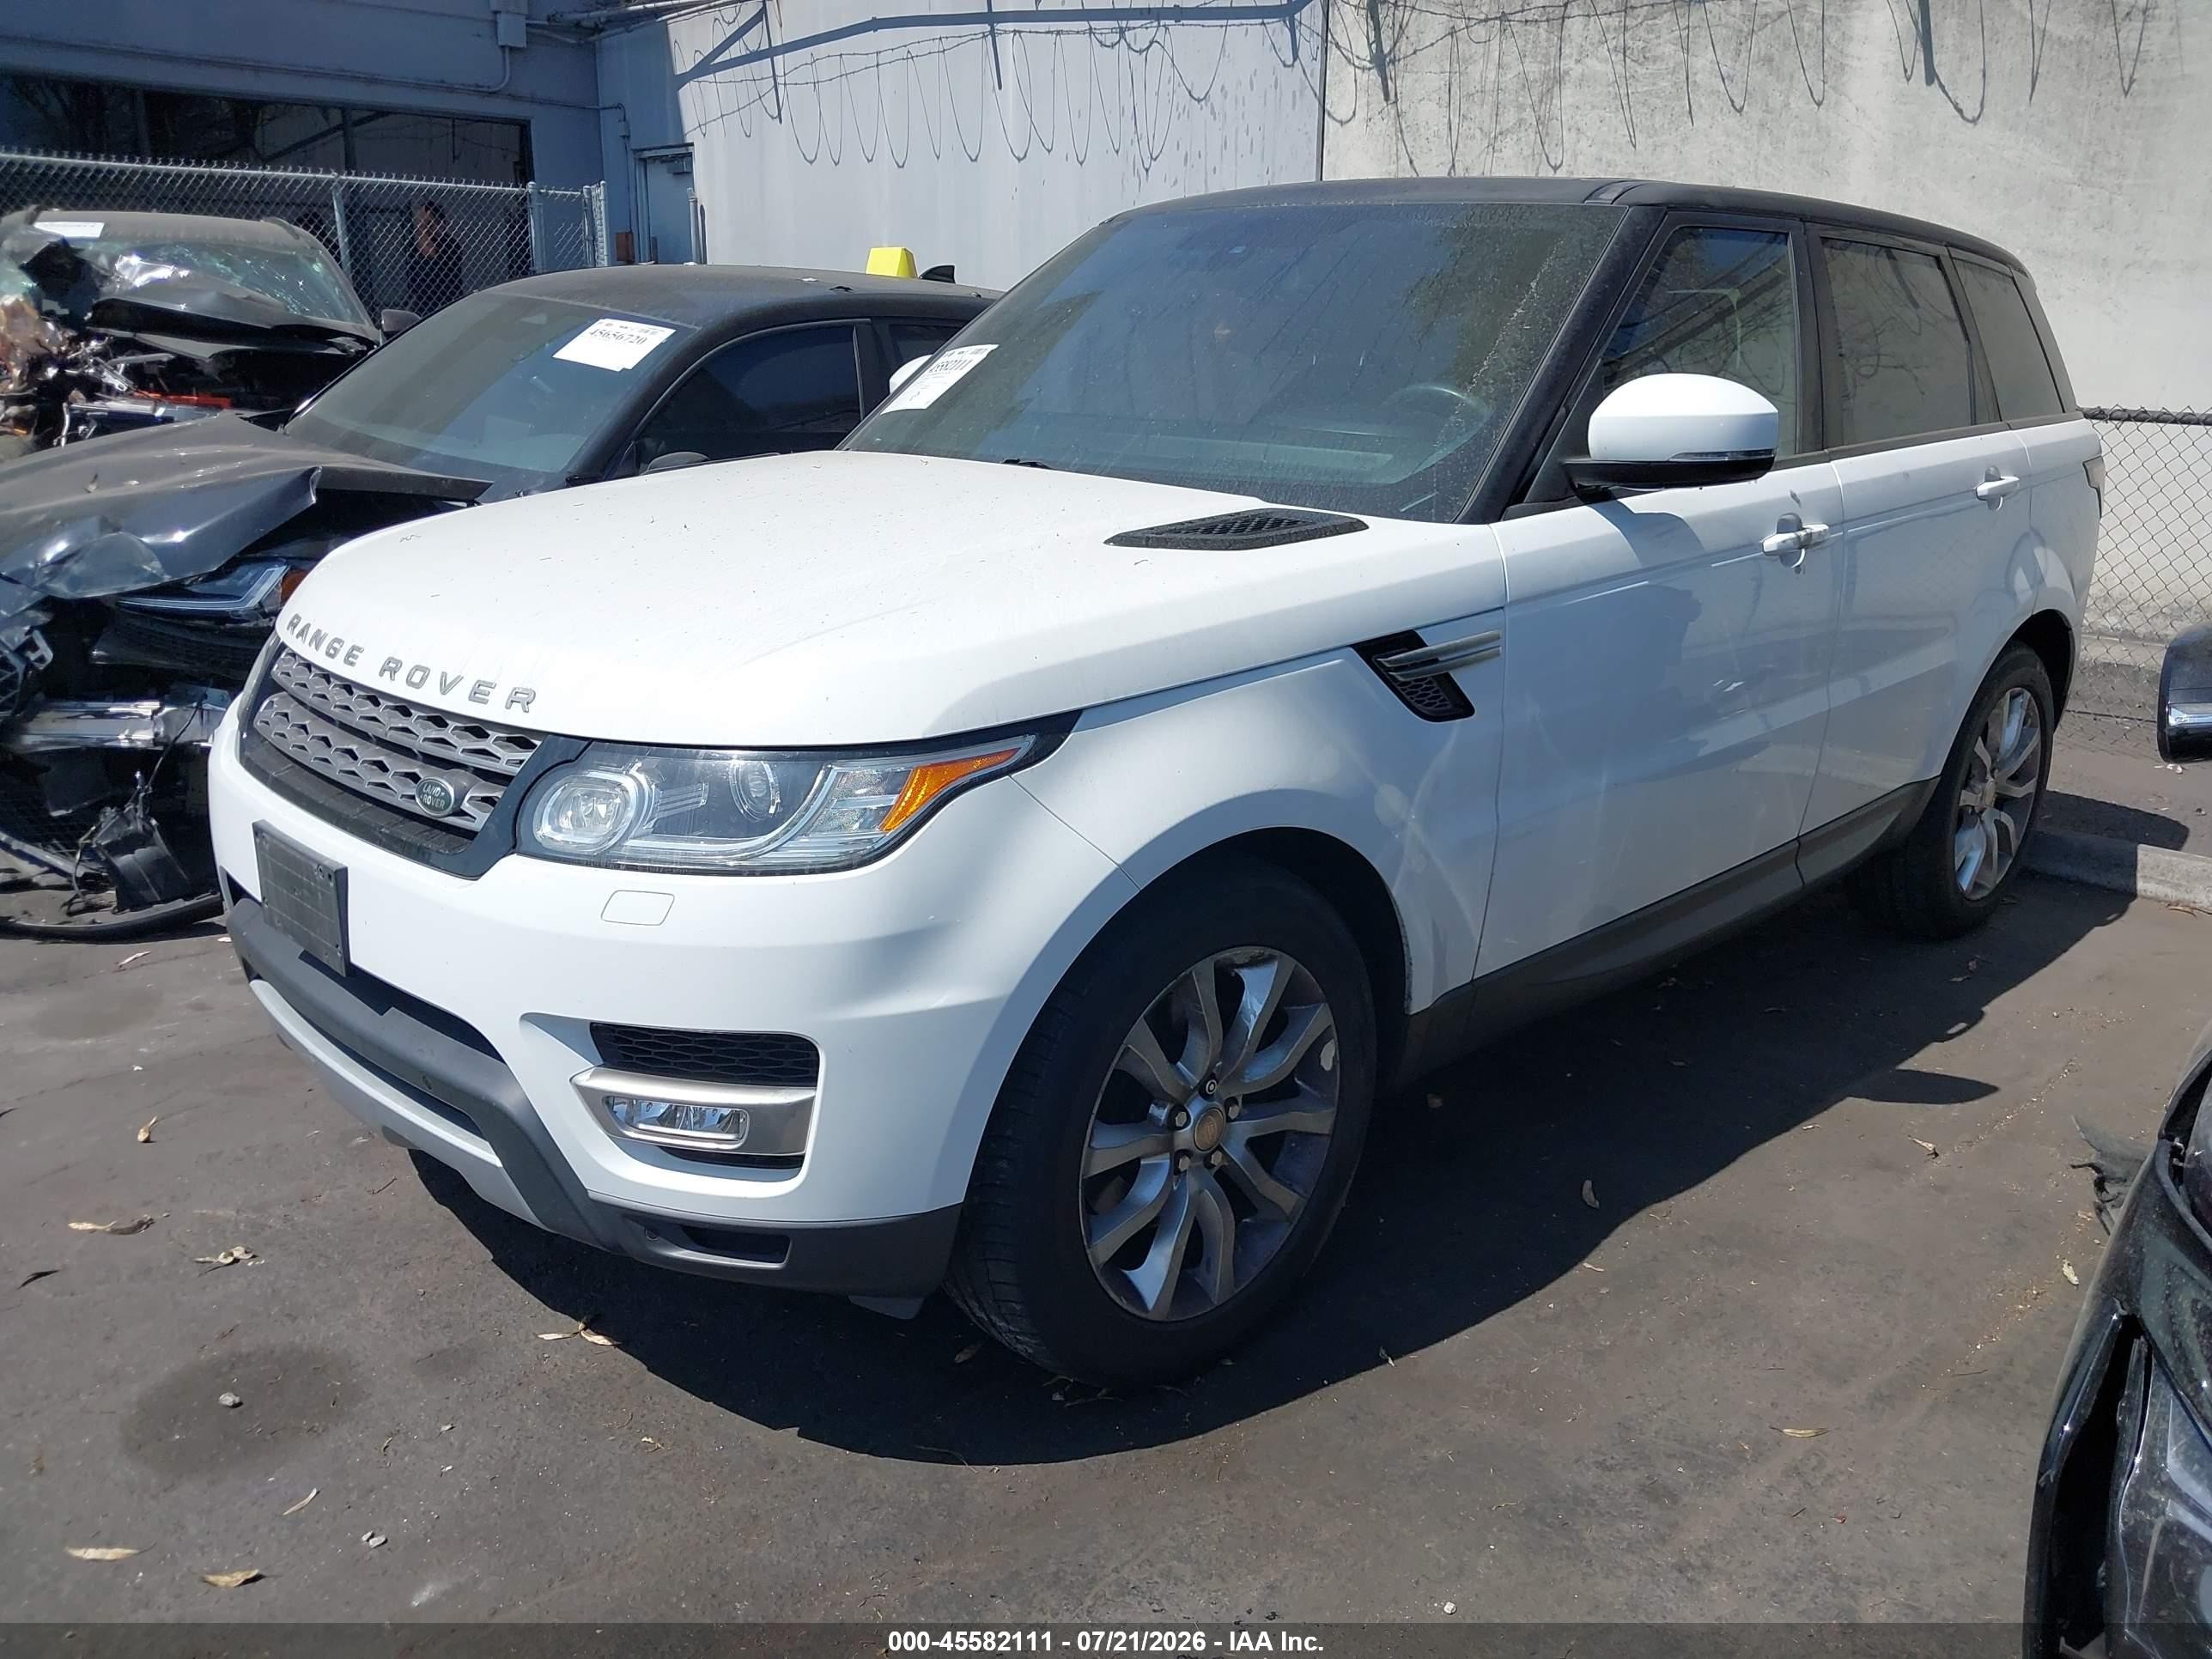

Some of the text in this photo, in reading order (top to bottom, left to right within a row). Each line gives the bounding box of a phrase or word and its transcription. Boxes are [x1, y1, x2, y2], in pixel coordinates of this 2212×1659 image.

[589, 328, 647, 345] 45656720
[286, 613, 536, 714] RANGE ROVER
[422, 782, 441, 797] LAND
[422, 793, 446, 810] ROVER
